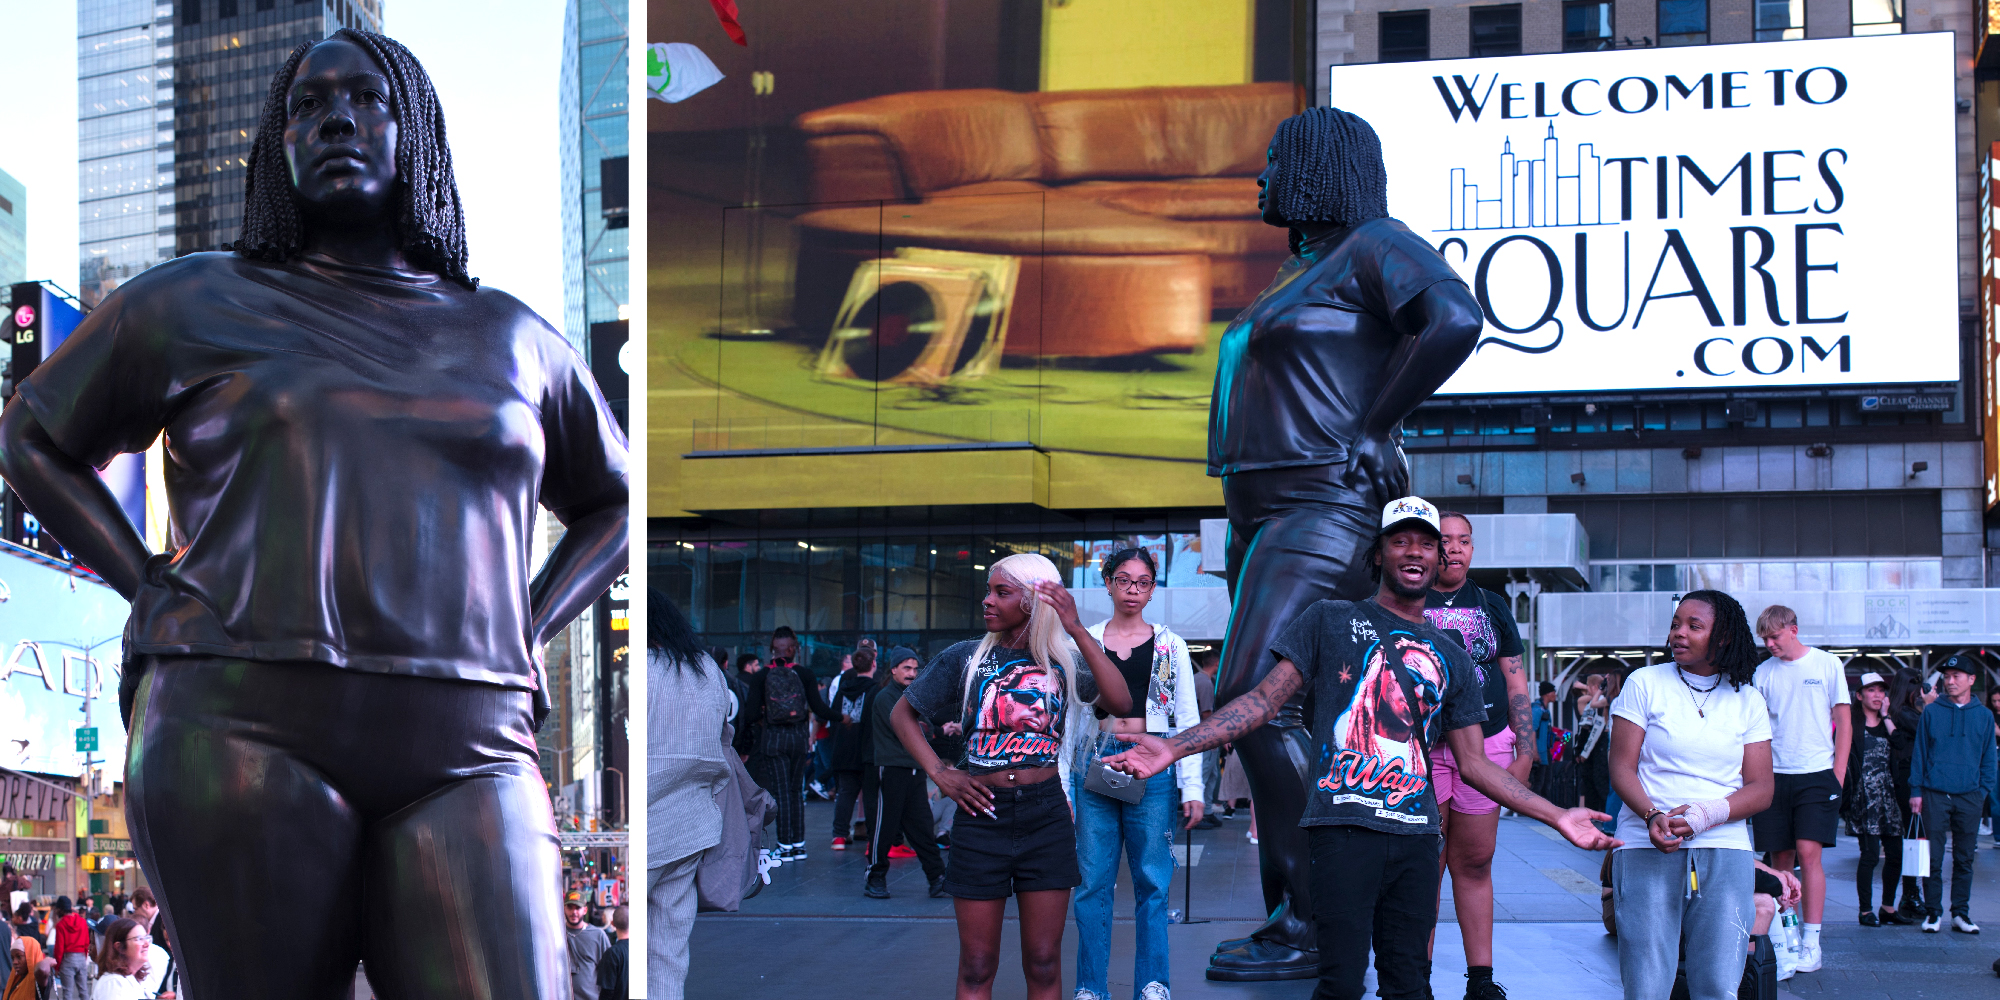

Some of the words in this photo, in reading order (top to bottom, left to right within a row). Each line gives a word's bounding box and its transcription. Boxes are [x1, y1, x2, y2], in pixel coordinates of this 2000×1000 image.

[1433, 72, 1751, 123] WELCOME
[1765, 67, 1848, 106] TO
[1603, 148, 1848, 221] TIMES
[16, 330, 34, 344] LG
[1676, 336, 1851, 377] .COM
